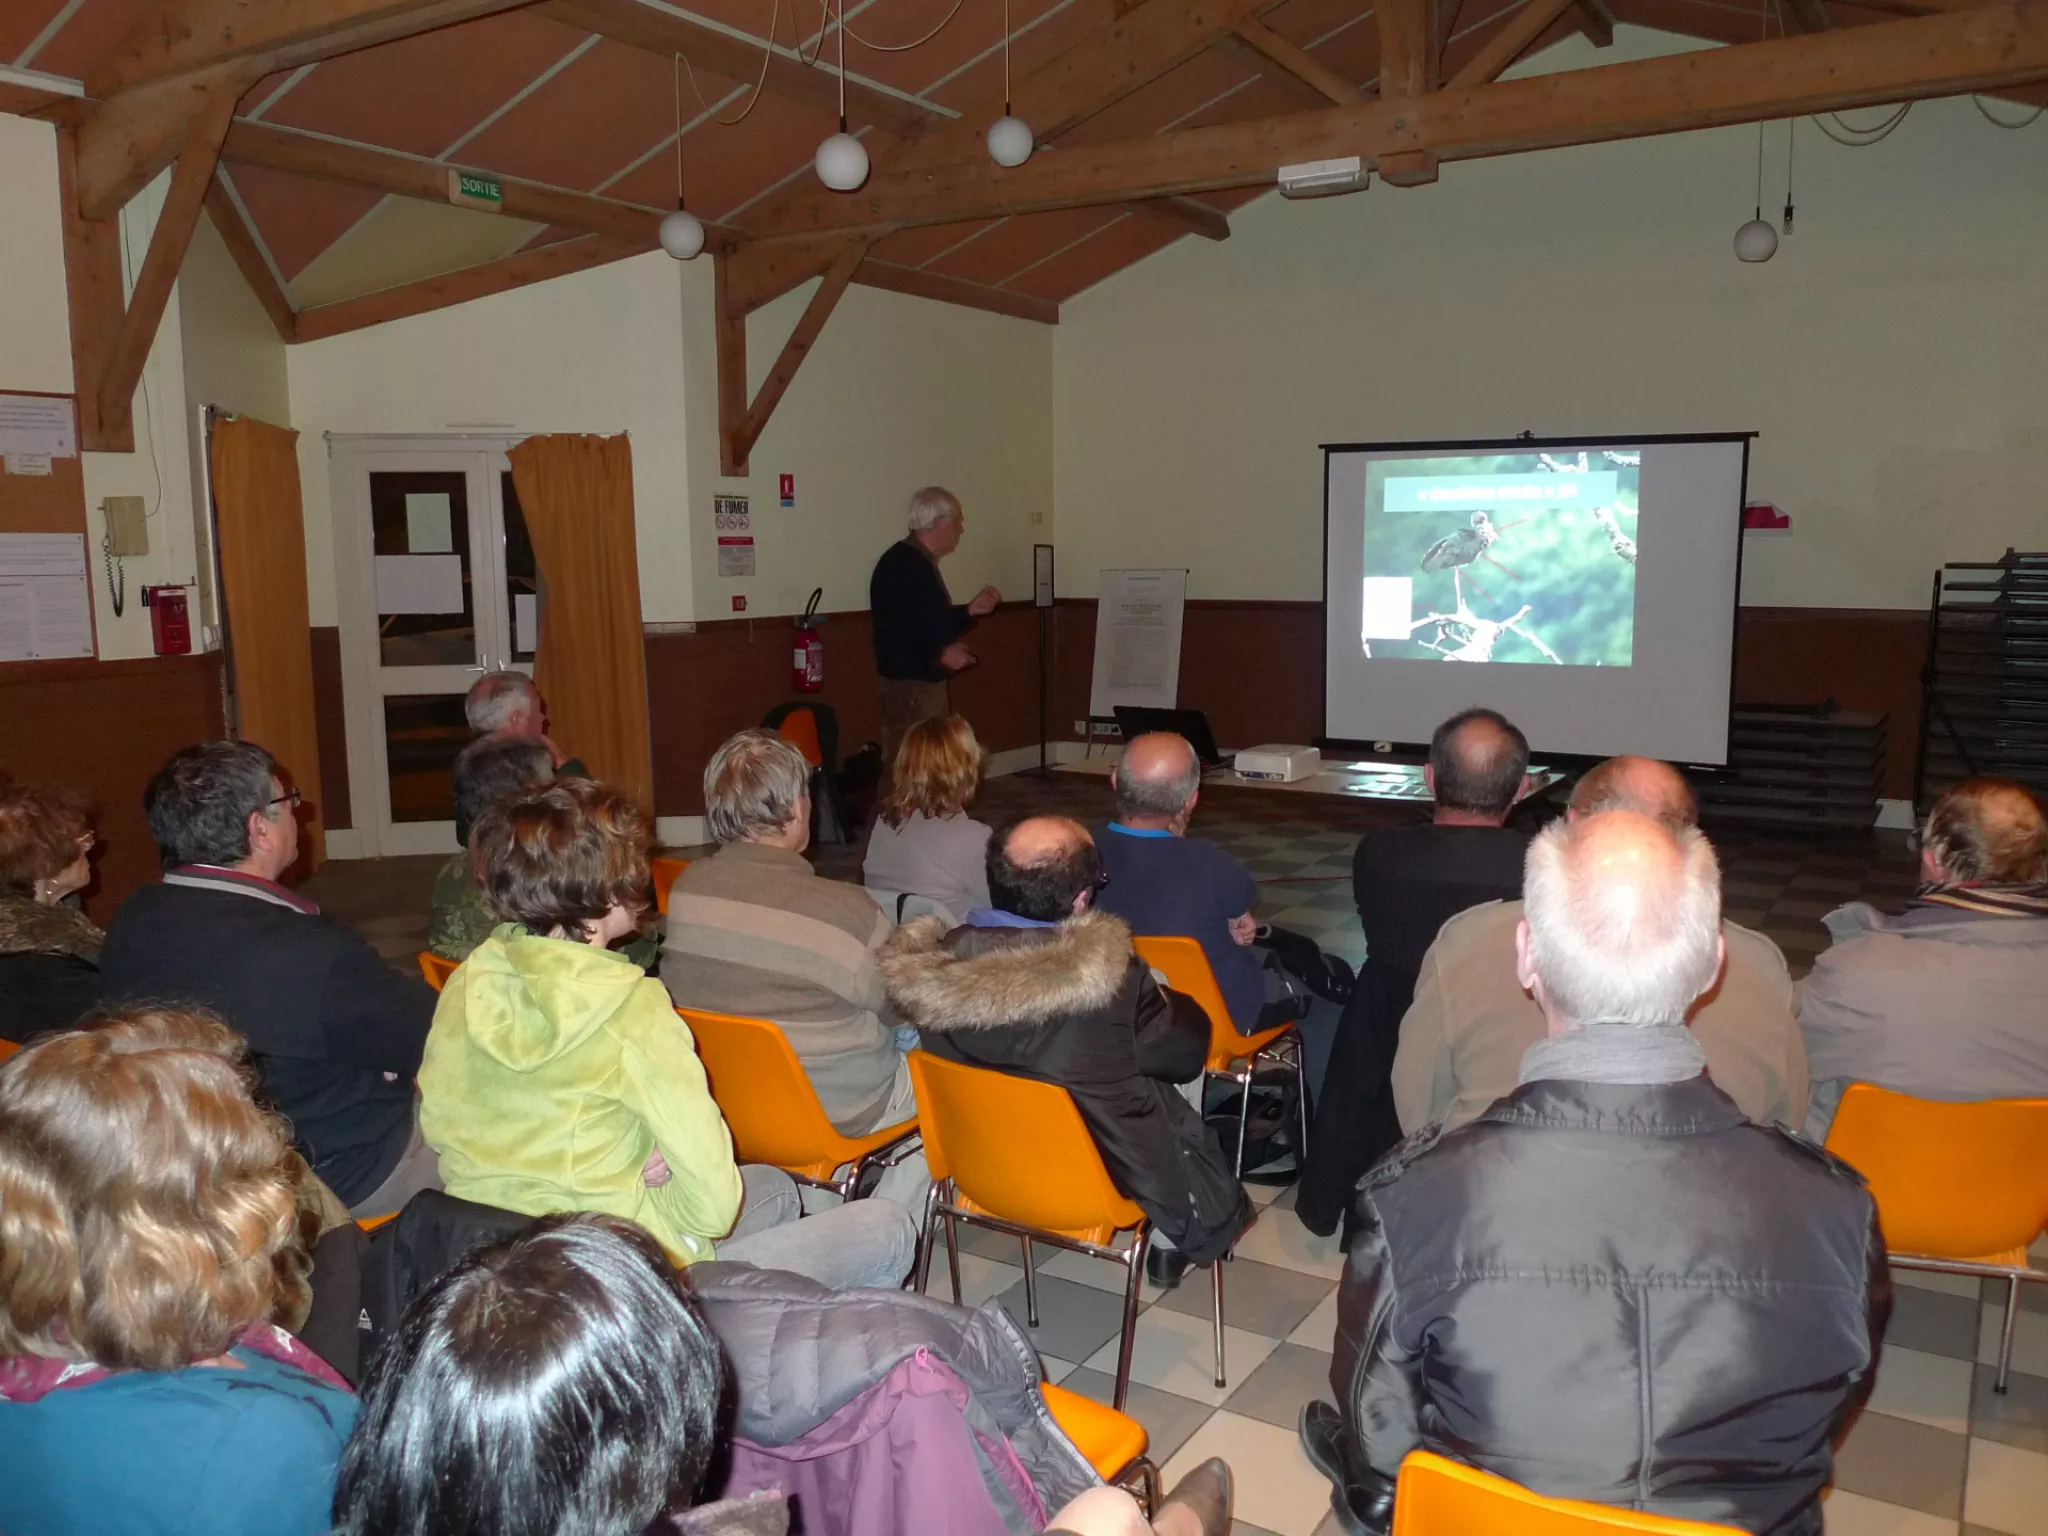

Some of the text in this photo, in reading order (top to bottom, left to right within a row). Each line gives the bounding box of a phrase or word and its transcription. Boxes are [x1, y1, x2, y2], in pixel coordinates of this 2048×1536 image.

[462, 177, 500, 197] SORTIE
[714, 499, 749, 515] DE FUMER
